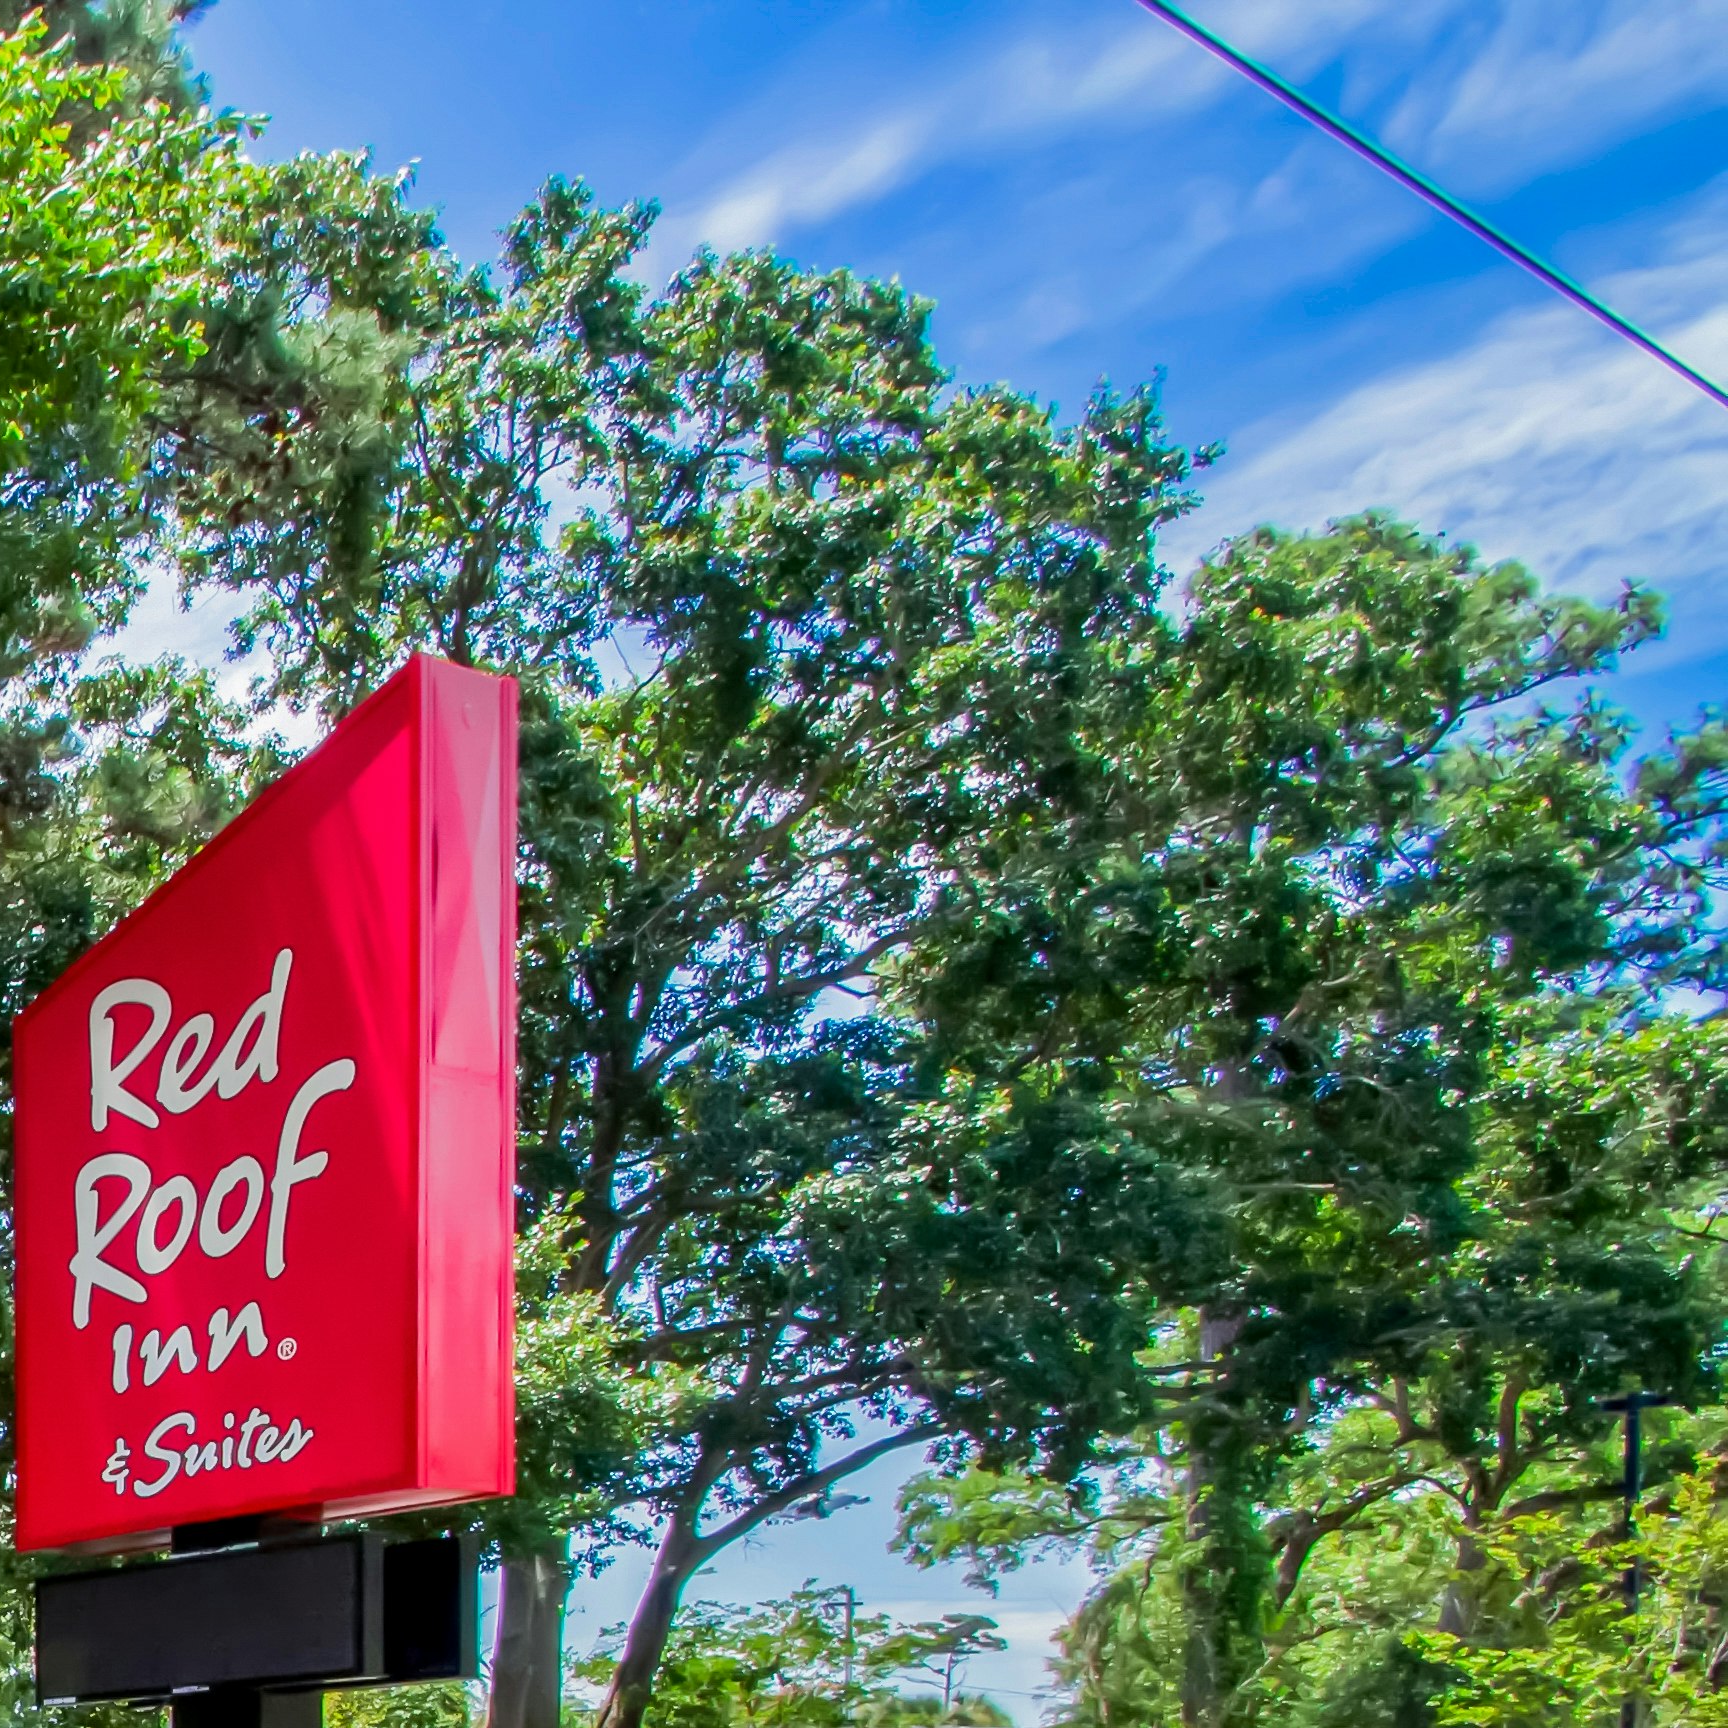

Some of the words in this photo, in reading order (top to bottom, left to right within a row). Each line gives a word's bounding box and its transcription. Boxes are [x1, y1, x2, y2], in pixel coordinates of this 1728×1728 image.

[89, 948, 293, 1132] Red
[69, 1058, 356, 1330] Roof
[101, 1437, 131, 1495] &
[133, 1407, 314, 1498] Suites
